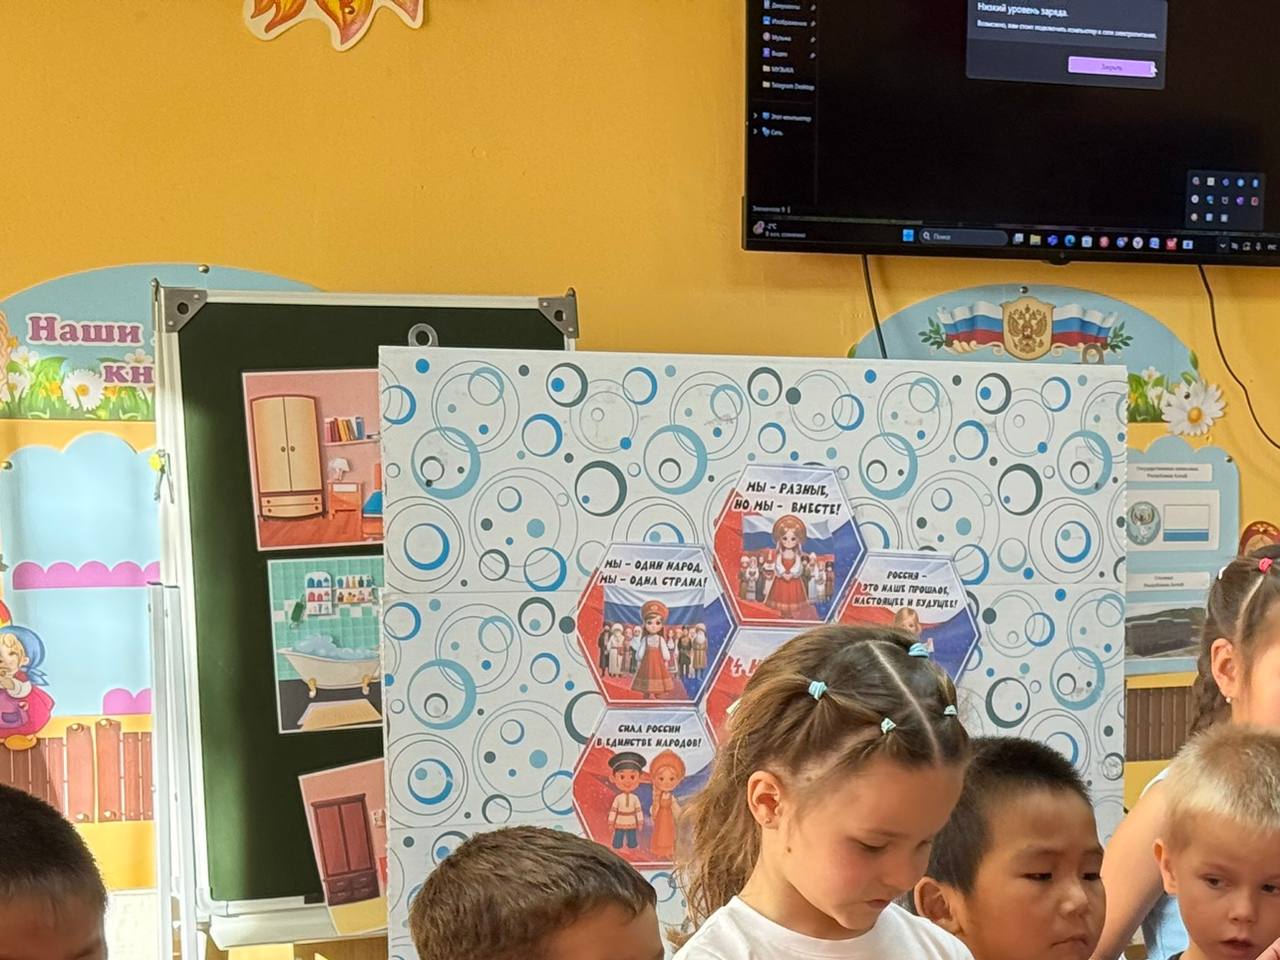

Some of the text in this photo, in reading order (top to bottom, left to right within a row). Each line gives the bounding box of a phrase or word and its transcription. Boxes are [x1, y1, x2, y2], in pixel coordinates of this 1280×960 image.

[978, 3, 1069, 18] Низкий уровень заряда.
[28, 315, 142, 344] Наши
[746, 481, 767, 492] МЫ
[779, 482, 829, 498] РАЗНЫЕ,
[734, 499, 750, 510] НО
[753, 500, 774, 512] МЫ
[791, 502, 842, 515] ВМЕСТЕ!
[604, 559, 622, 569] МЫ
[635, 560, 664, 571] ОДИН
[666, 561, 703, 573] НАРОД,
[600, 574, 617, 584] МЫ
[630, 575, 658, 586] ОДНА
[662, 576, 708, 588] СТРАНА!
[887, 570, 919, 580] РОССИЯ
[863, 583, 949, 596] ЭТО НАШЕ ПРОШЛОЕ,
[853, 597, 958, 610] НАСТОЯЩЕЕ И БУДУЩЕЕ!
[618, 724, 681, 733] СИЛА РОССИИ
[596, 738, 702, 748] В ЕДИНСТВЕ НАРОДОВ!
